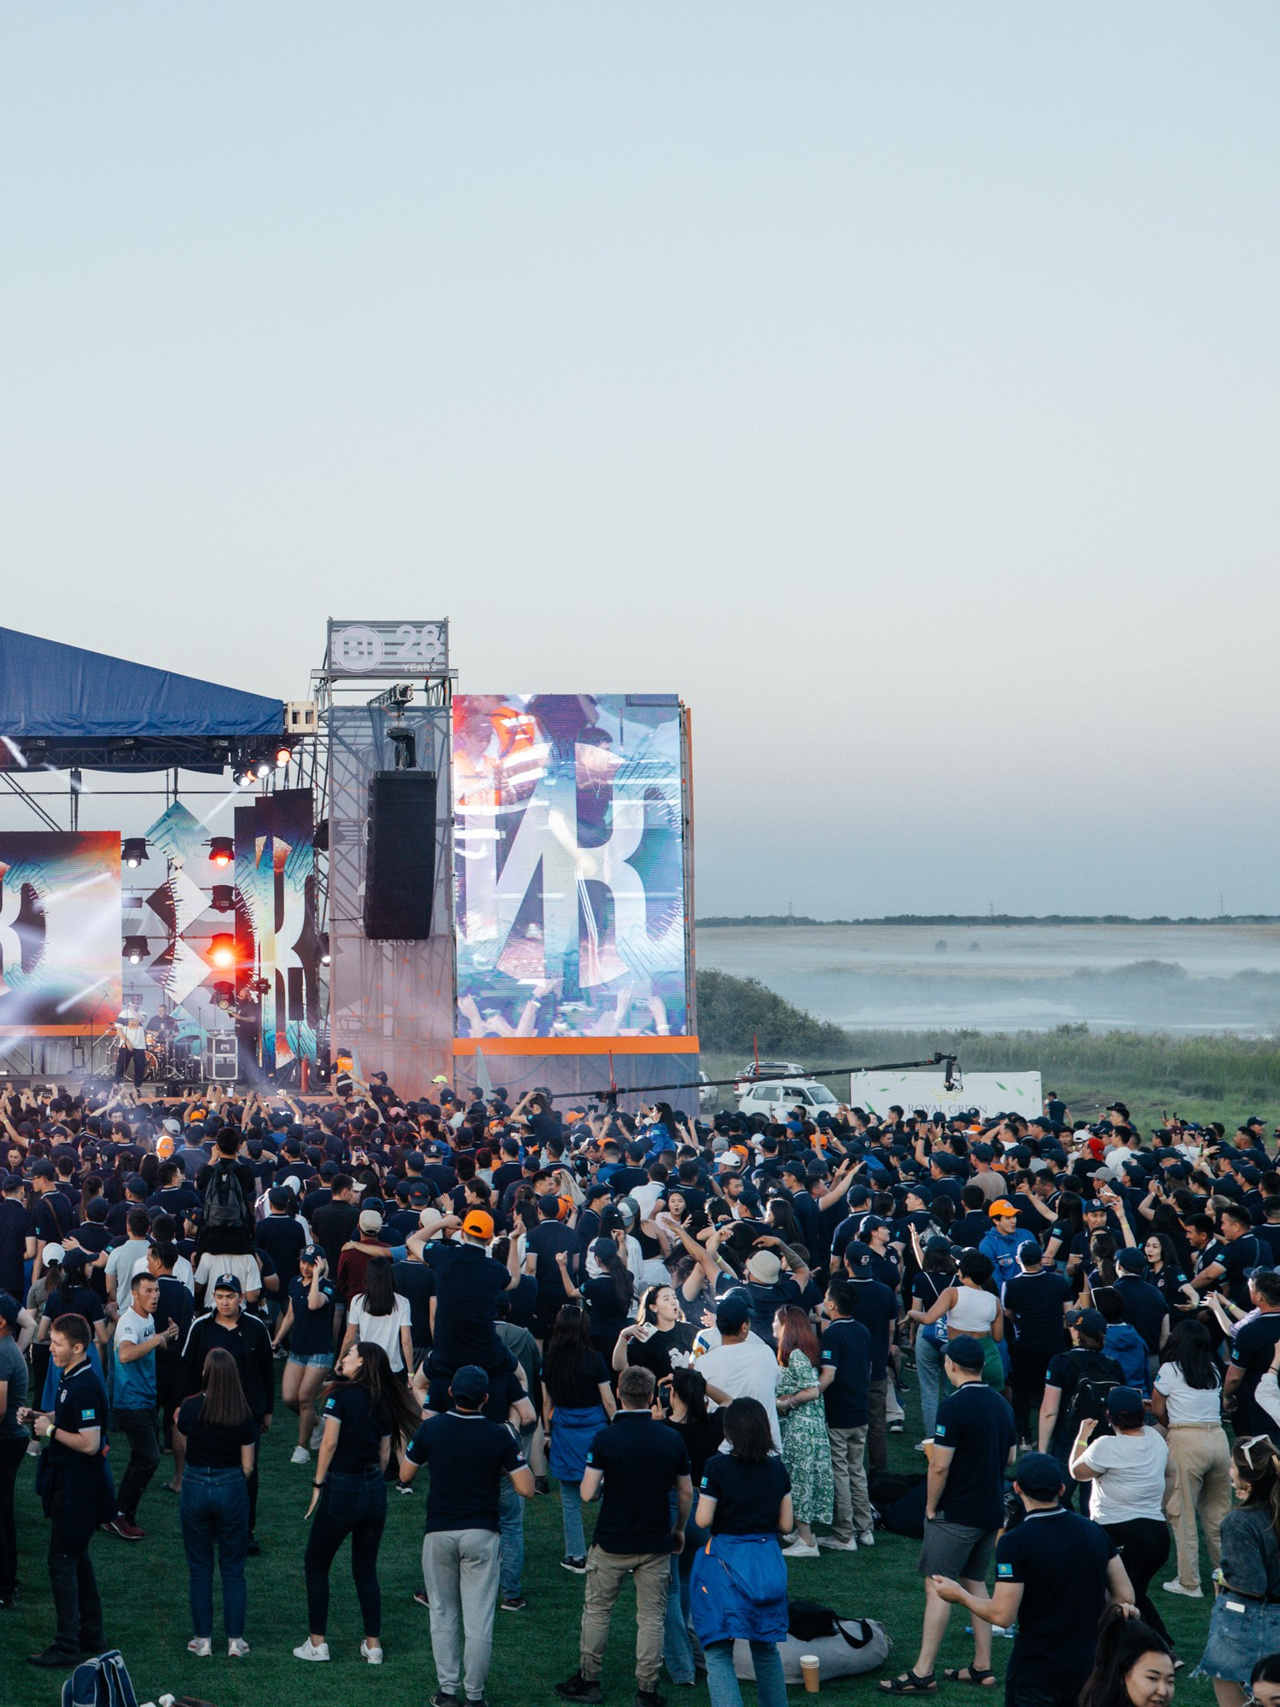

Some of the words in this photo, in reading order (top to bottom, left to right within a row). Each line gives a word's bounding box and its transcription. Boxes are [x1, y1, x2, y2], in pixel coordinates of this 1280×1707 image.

[395, 624, 442, 658] 28
[402, 663, 437, 672] YEARS
[908, 1104, 942, 1114] ROYAL
